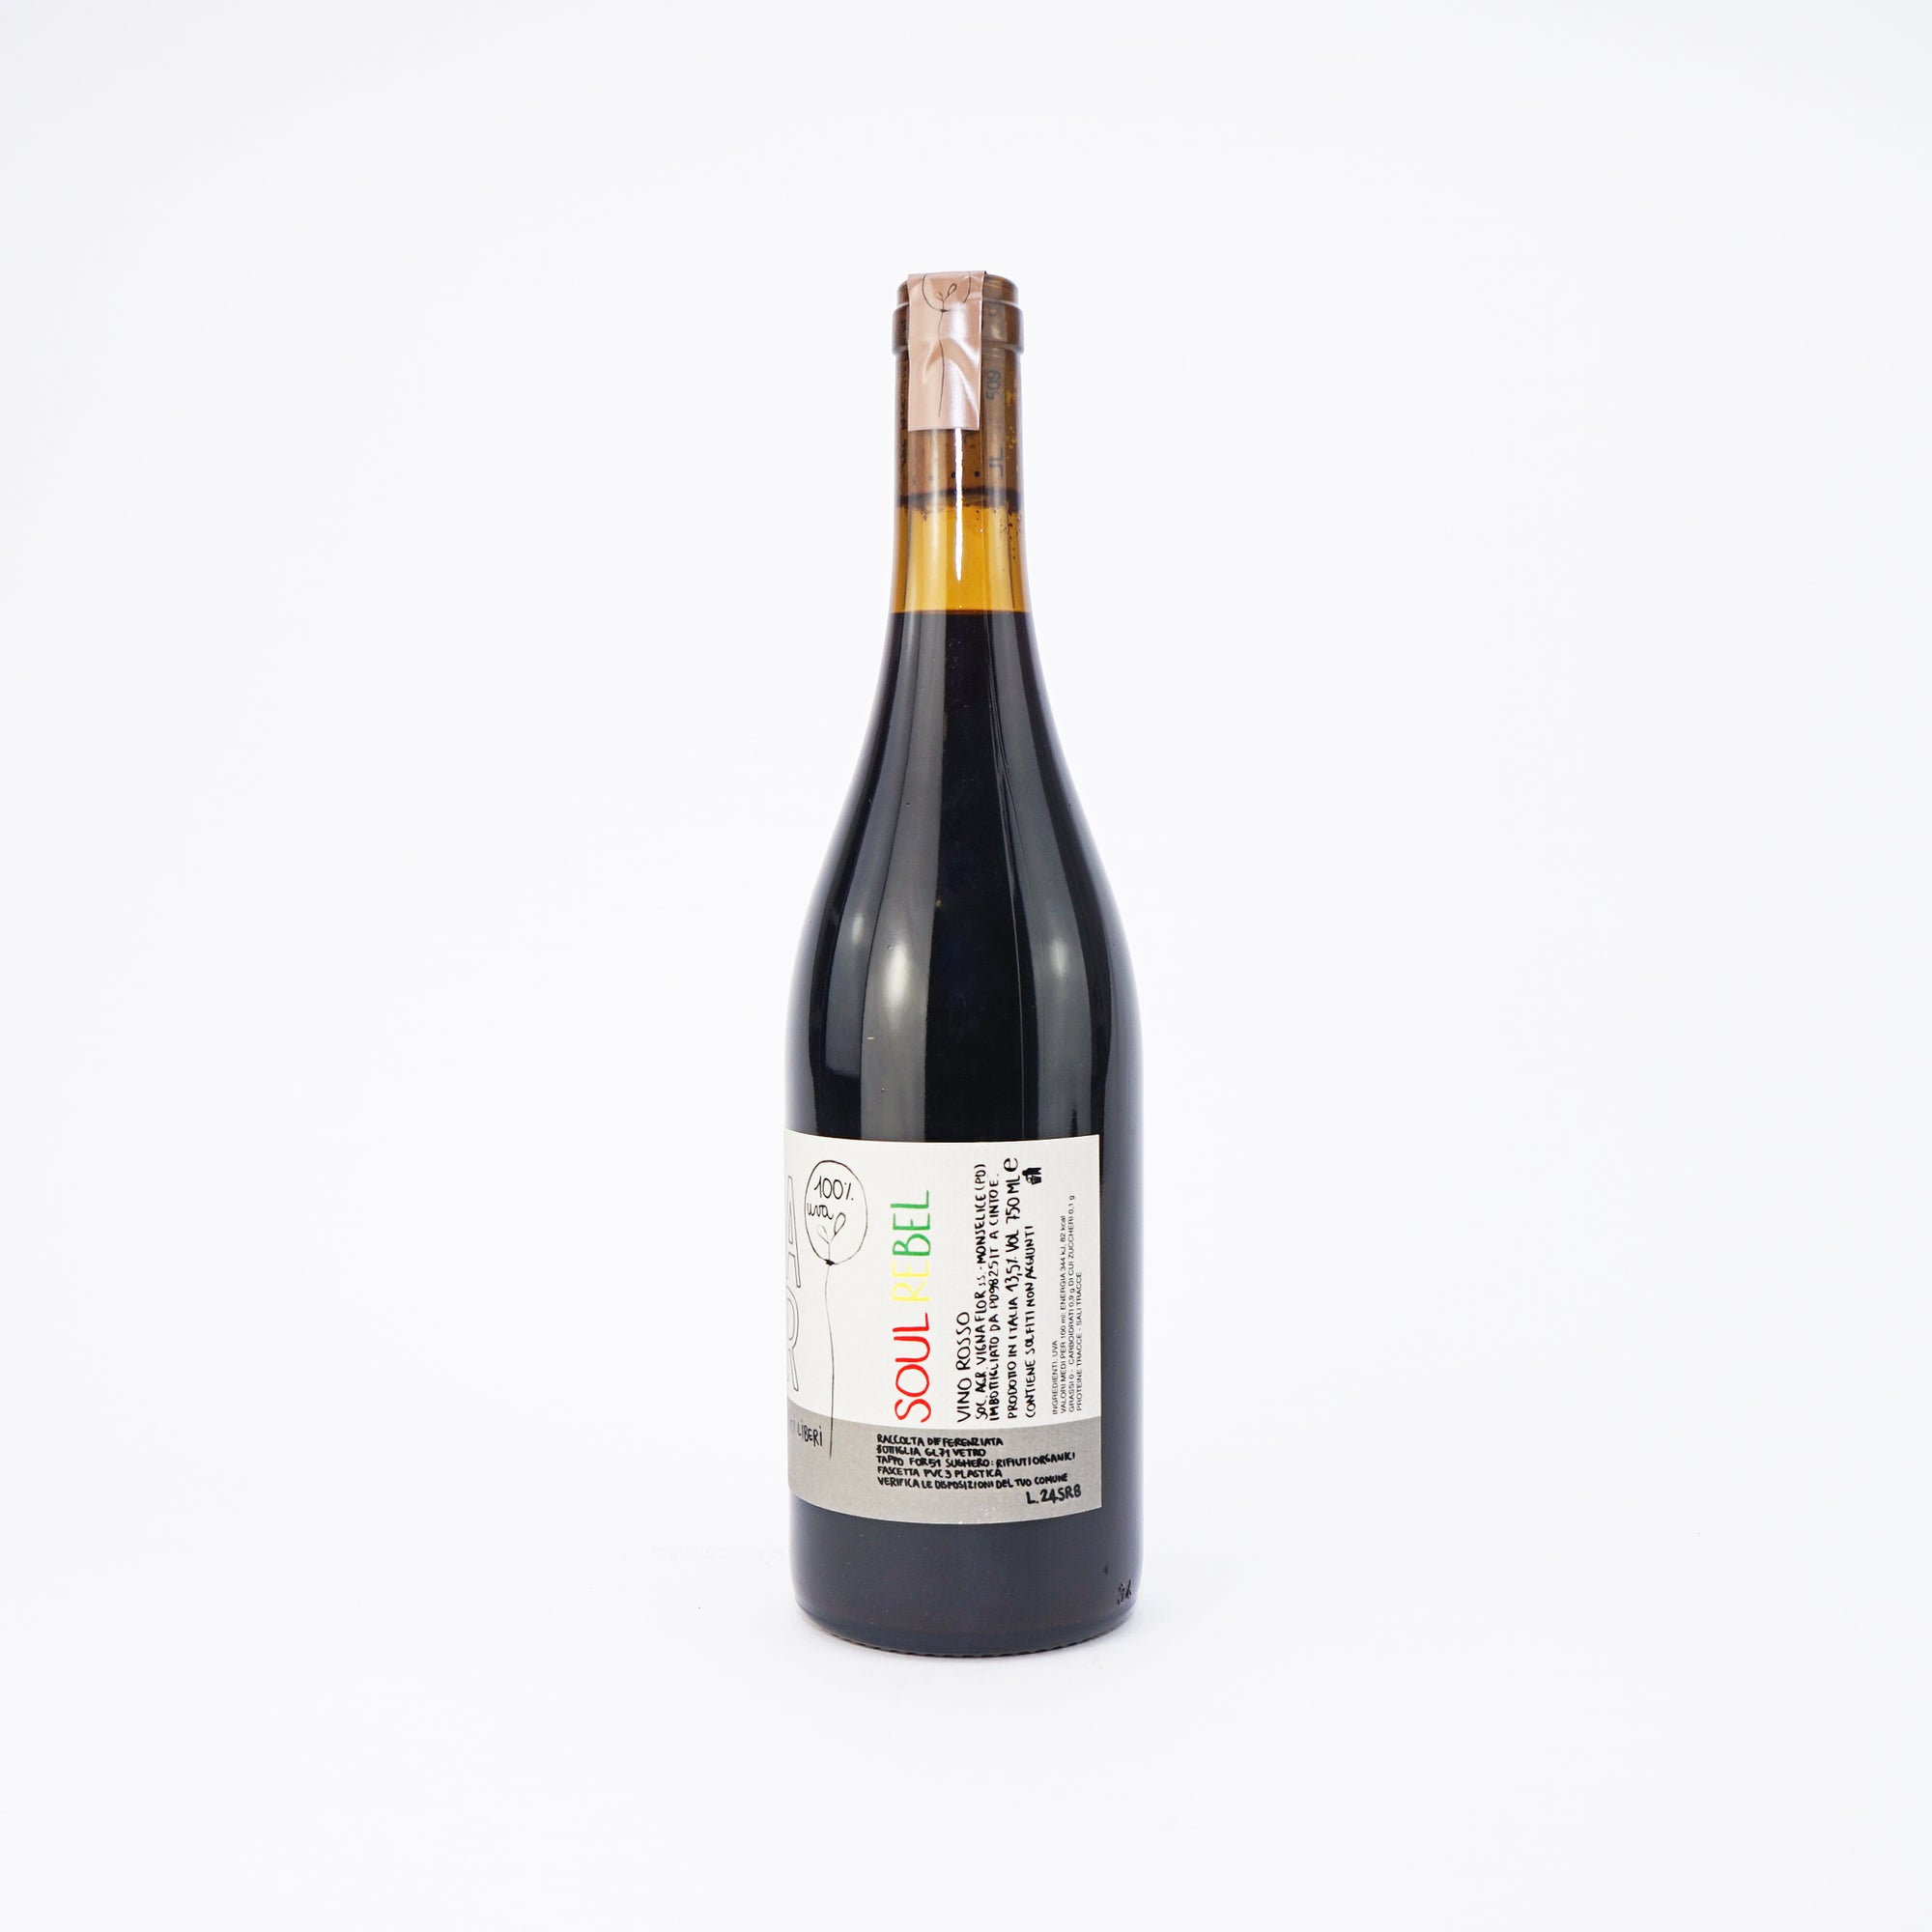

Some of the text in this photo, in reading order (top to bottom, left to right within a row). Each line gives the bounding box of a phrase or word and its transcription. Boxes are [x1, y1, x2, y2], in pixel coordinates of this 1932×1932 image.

[814, 1176, 854, 1201] 100%
[974, 1164, 986, 1190] (PD)
[1006, 1175, 1020, 1194] ML
[807, 1203, 834, 1220] uva
[988, 1189, 999, 1226] CINTO
[1006, 1197, 1020, 1224] 750
[975, 1194, 986, 1264] MONSELICE
[989, 1231, 999, 1239] A
[1060, 1233, 1065, 1242] 82
[1006, 1230, 1019, 1252] VOL
[1005, 1257, 1023, 1292] 13,5%
[891, 1190, 931, 1423] SOUL REBEL
[1008, 1296, 1018, 1339] ITALIA
[988, 1314, 1001, 1331] DA
[1024, 1226, 1037, 1418] CONTIENE SOLFITI NON AGGIUNTI
[1008, 1345, 1017, 1357] IN
[955, 1312, 972, 1423] VINO ROSSO
[988, 1337, 1000, 1421] IMBOTTIGLIATO
[1008, 1361, 1018, 1418] PRODOTTO
[877, 1434, 1004, 1446] RACCOLTA DIFFERENZIATA
[876, 1456, 903, 1465] TAPPO
[909, 1458, 941, 1466] FOR51
[996, 1457, 1031, 1468] RIFIUTI
[1033, 1452, 1075, 1464] ORGANICI
[925, 1448, 950, 1458] GL71
[877, 1466, 1003, 1478] FASCETTA PVC 3 PLASTICA
[877, 1477, 920, 1488] VERIFICA
[935, 1480, 994, 1490] DISPOSIZIONI
[996, 1479, 1013, 1489] DEL
[1015, 1478, 1032, 1487] TUO
[1035, 1473, 1067, 1484] COMUNE
